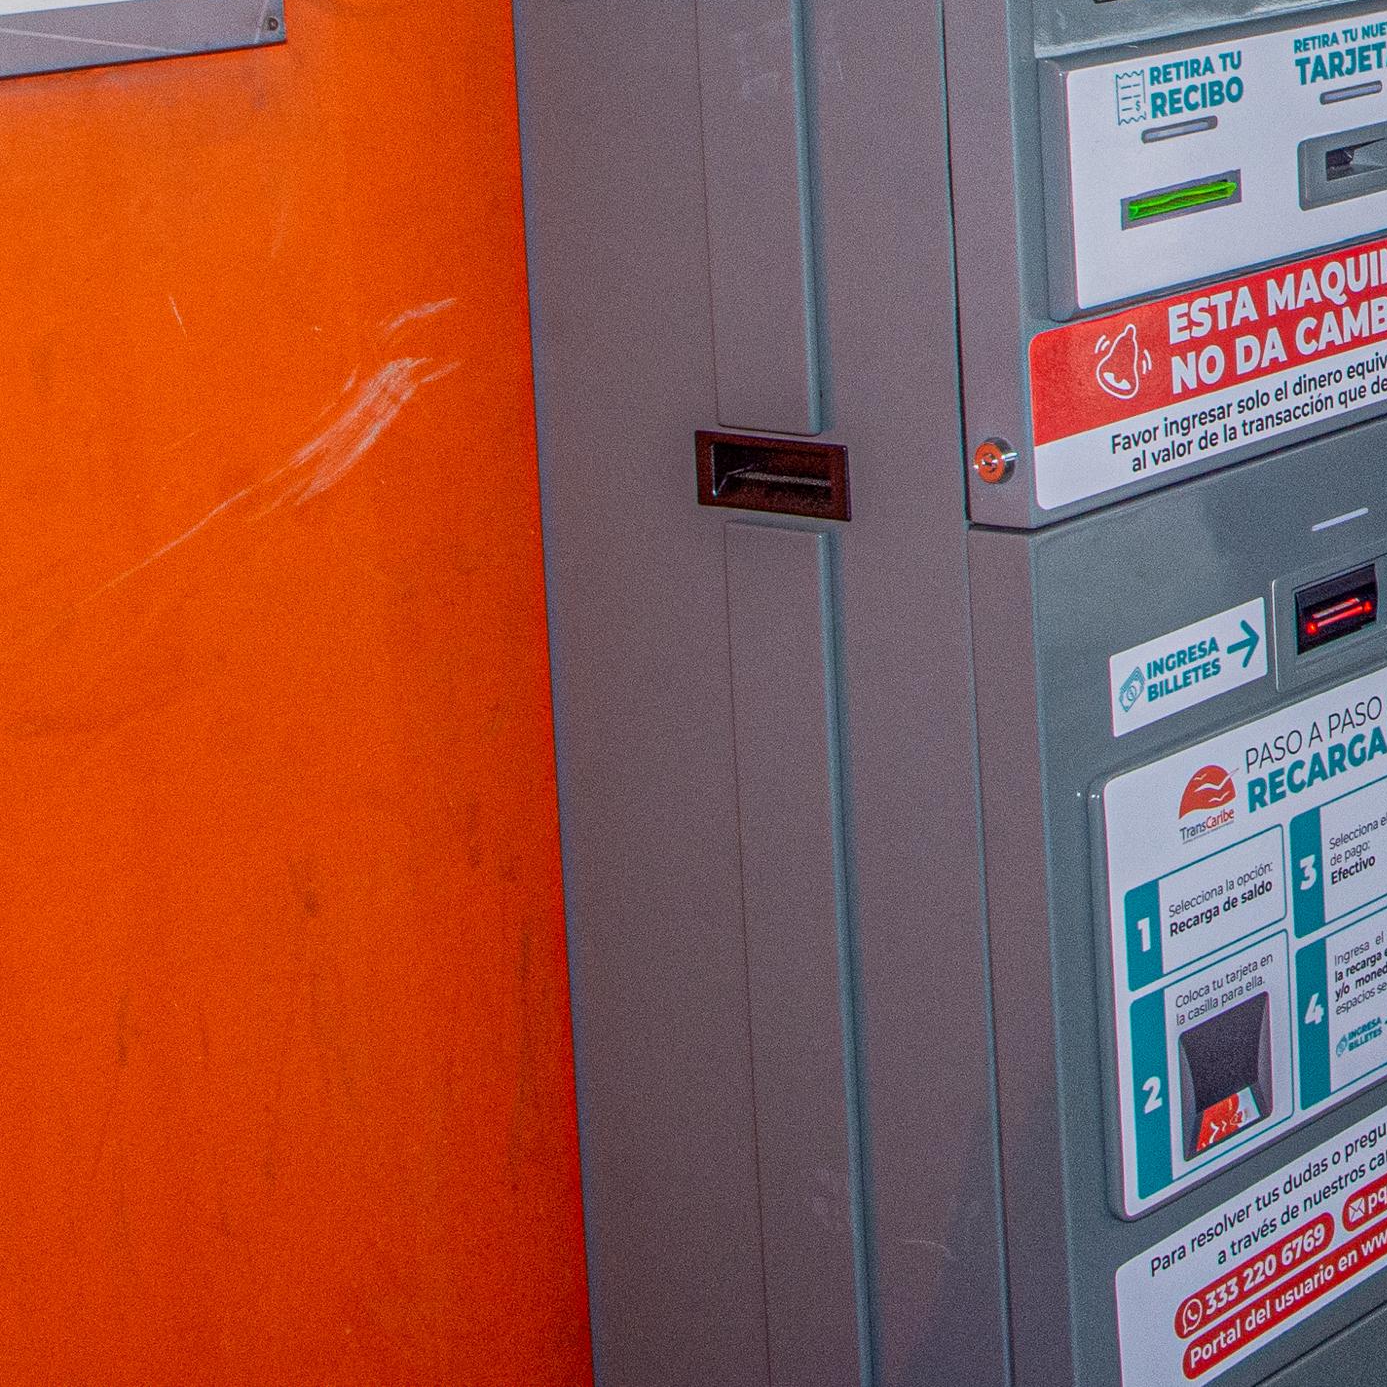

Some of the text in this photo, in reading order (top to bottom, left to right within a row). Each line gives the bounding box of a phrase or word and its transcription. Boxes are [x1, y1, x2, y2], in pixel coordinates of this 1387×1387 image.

[1150, 50, 1242, 86] RETIRA TU
[1294, 32, 1339, 54] RETIRA
[1342, 28, 1358, 43] TU
[1151, 76, 1244, 119] RECIBO
[1168, 285, 1258, 345] ESTA
[1171, 345, 1226, 394] NO
[1235, 327, 1288, 375] DA
[1111, 425, 1159, 454] Favor
[1164, 402, 1233, 437] ingresar
[1237, 390, 1270, 414] solo
[1275, 380, 1288, 402] el
[1293, 369, 1342, 396] dinero
[1132, 450, 1147, 472] al
[1151, 440, 1194, 465] valor
[1198, 430, 1218, 451] de
[1223, 424, 1237, 443] la
[1242, 393, 1334, 437] transacción
[1338, 385, 1367, 408] que
[1147, 637, 1220, 680] INGRESA
[1147, 657, 1222, 702] BILLETES
[1245, 730, 1303, 774] PASO
[1308, 722, 1323, 748] A
[1328, 696, 1382, 739] PASO
[1178, 808, 1235, 841] TransCaribe
[1299, 854, 1317, 891] 3
[1329, 820, 1378, 850] Selecciona
[1380, 812, 1387, 827] el
[1330, 840, 1371, 867] de pago:
[1331, 856, 1376, 885] Efectivo
[1137, 862, 1274, 953] 1 Selecciona la opción:
[1170, 880, 1273, 938] Recarga de saldo
[1304, 992, 1325, 1025] 4
[1334, 941, 1370, 967] Ingresa
[1375, 932, 1384, 946] el
[1335, 982, 1350, 1002] y/o
[1345, 951, 1383, 977] recarga
[1187, 974, 1266, 1021] casilla para ella.
[1336, 987, 1376, 1016] espacios
[1142, 953, 1274, 1114] 2 Coloca tu tarjeta en
[1150, 1245, 1187, 1277] Para
[1191, 1203, 1252, 1252] resolver
[1254, 1187, 1280, 1211] tus
[1283, 1157, 1328, 1195] dudas
[1332, 1151, 1341, 1165] o
[1217, 1250, 1226, 1265] a
[1230, 1217, 1277, 1257] través
[1280, 1205, 1299, 1225] de
[1303, 1164, 1366, 1212] nuestros
[1205, 1223, 1326, 1315] 333 220 6769
[1190, 1319, 1241, 1369] Portal
[1245, 1300, 1270, 1331] del
[1275, 1264, 1335, 1312] usuario
[1338, 1249, 1358, 1271] en
